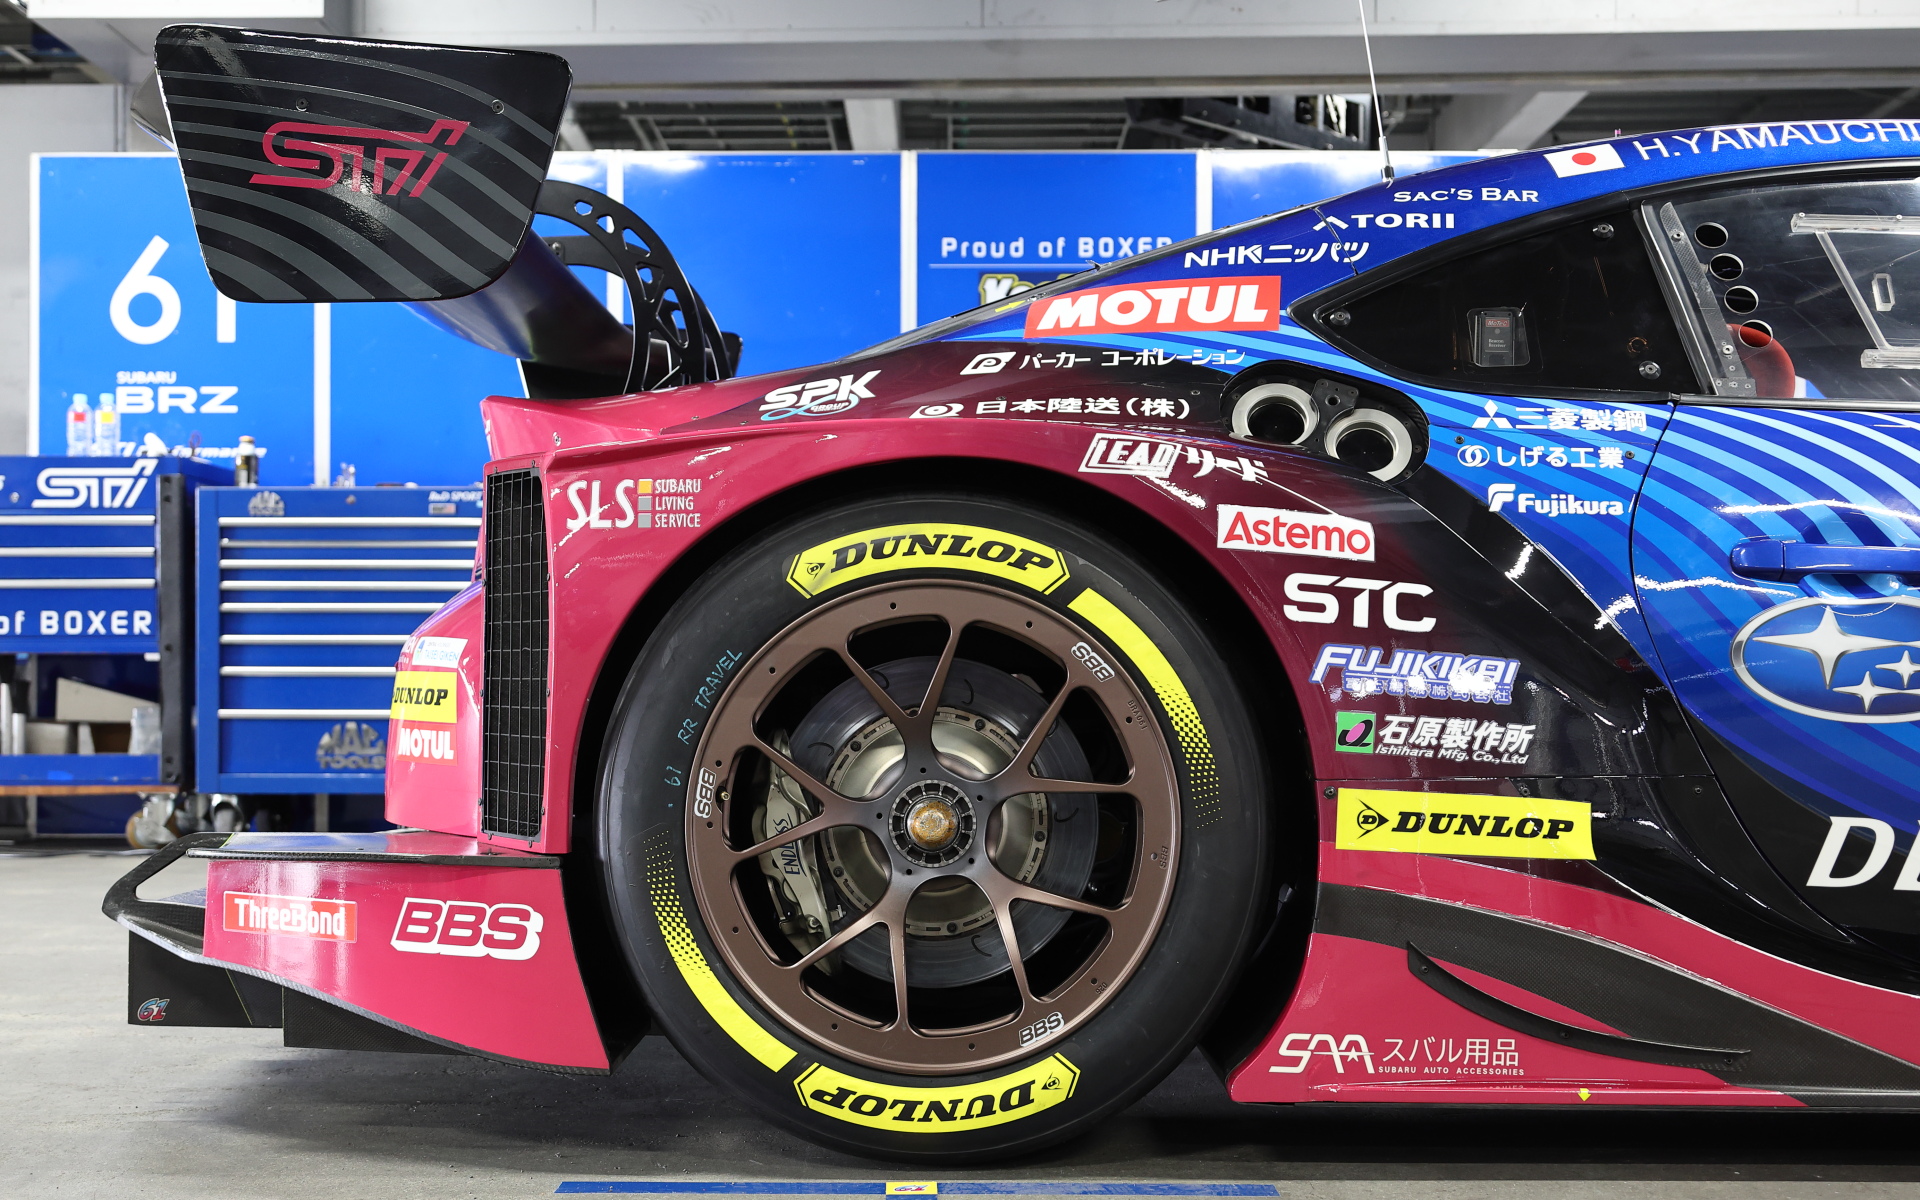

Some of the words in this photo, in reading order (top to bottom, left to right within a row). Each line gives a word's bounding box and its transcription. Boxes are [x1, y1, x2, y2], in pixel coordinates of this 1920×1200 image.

[249, 119, 470, 198] STI
[1394, 188, 1473, 203] SAC'S
[941, 237, 1025, 258] Proud
[1038, 237, 1066, 258] of
[1037, 284, 1268, 330] MOTUL
[1019, 353, 1091, 370] パーカー
[1101, 348, 1246, 367] コーポレーション
[116, 371, 177, 384] SUBARU
[759, 370, 881, 411] SPK
[116, 386, 239, 414] BRZ
[1515, 407, 1648, 432] 三菱製鋼
[1088, 440, 1174, 470] LEAD
[1185, 446, 1269, 481] リード
[1496, 446, 1624, 469] しげる工業
[31, 458, 160, 508] STI
[654, 479, 702, 494] SUBARU
[566, 479, 634, 529] SLS
[655, 496, 694, 511] LIVING
[1518, 493, 1624, 517] Fujikura
[654, 513, 702, 529] SERVICE
[1222, 511, 1371, 555] Astemo
[830, 533, 1055, 573] DUNLOP
[1283, 572, 1437, 633] STC
[40, 610, 152, 635] BOXER
[1071, 641, 1115, 682] BBS
[393, 687, 449, 706] DUNLOP
[677, 718, 698, 745] RR
[694, 649, 743, 709] TRAVEL
[398, 727, 455, 760] MOTUL
[1378, 715, 1536, 754] 石原製作所
[1375, 744, 1433, 758] Ishihara
[1438, 750, 1469, 762] Mfg.
[694, 767, 716, 819] BBS
[1391, 811, 1574, 839] DUNLOP
[773, 818, 800, 875] ENDLSS
[234, 897, 345, 937] ThreeBond
[390, 897, 544, 961] BBS
[137, 997, 170, 1021] 61
[1018, 1011, 1065, 1047] BBS
[1382, 1036, 1519, 1066] スバル用品
[1378, 1066, 1417, 1074] SUBARU
[1423, 1066, 1449, 1074] AUTO
[1456, 1067, 1525, 1076] ACCESSORIES
[809, 1080, 1036, 1122] DUNLOP
